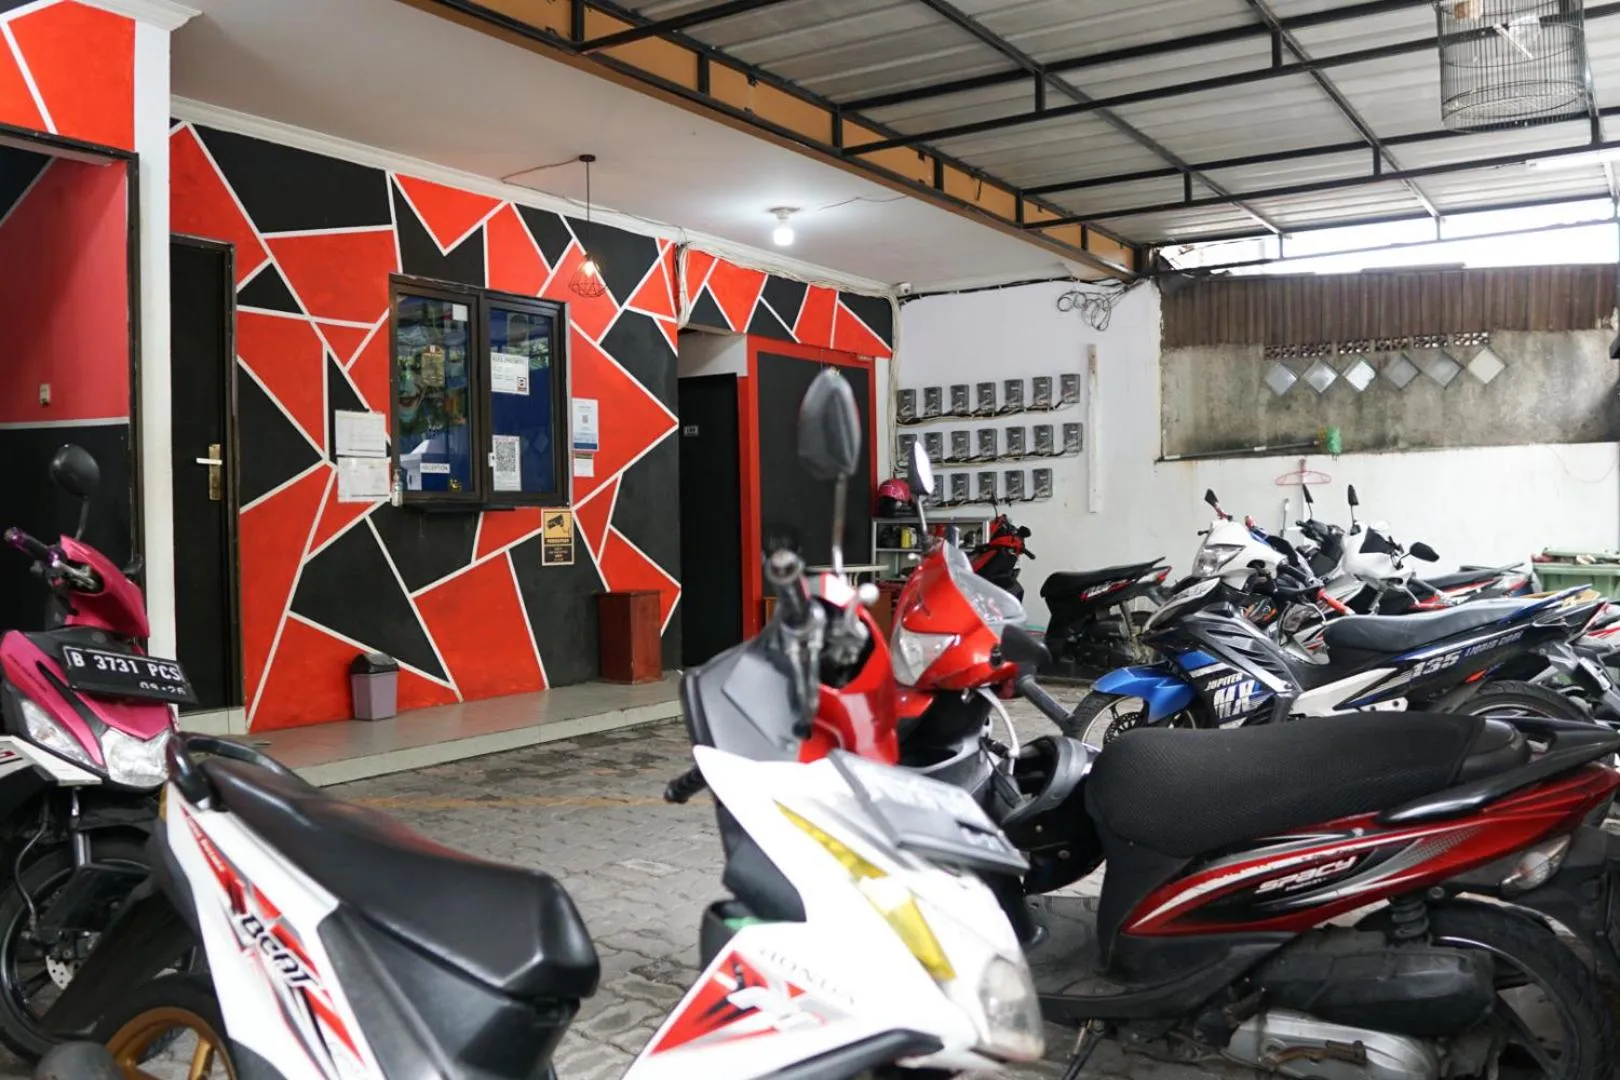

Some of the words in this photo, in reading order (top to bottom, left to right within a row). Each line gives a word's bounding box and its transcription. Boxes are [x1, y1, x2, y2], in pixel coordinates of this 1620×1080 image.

[70, 651, 85, 667] B
[93, 655, 139, 674] 3731
[147, 663, 182, 681] PCS
[1411, 650, 1462, 677] 135
[1204, 673, 1243, 691] JUPITER
[1213, 680, 1258, 719] MX
